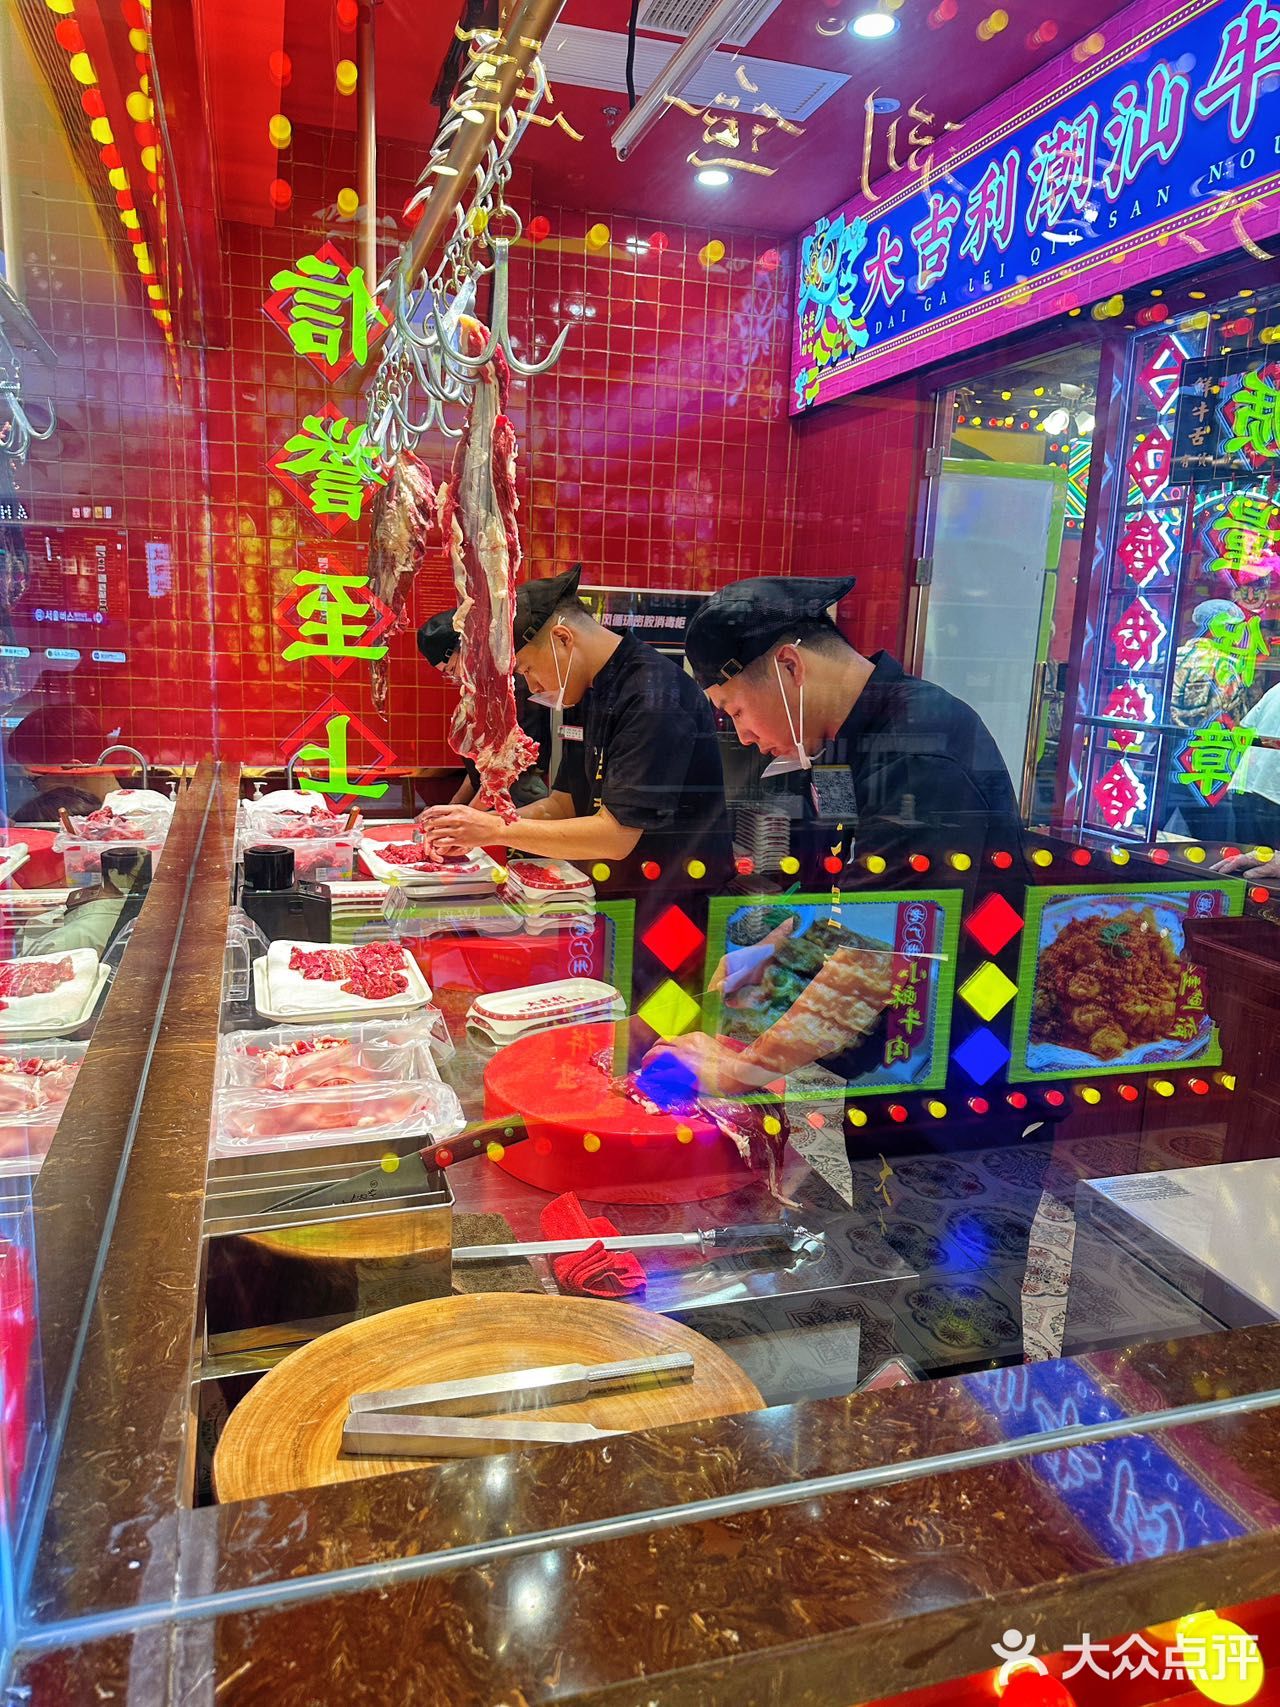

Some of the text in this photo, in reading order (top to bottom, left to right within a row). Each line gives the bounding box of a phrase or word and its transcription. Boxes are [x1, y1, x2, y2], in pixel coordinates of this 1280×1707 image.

[875, 310, 906, 334] DAI
[924, 292, 948, 313] GA
[968, 268, 1006, 293] LEI
[1030, 230, 1079, 266] QIU
[1108, 187, 1171, 229] SAN
